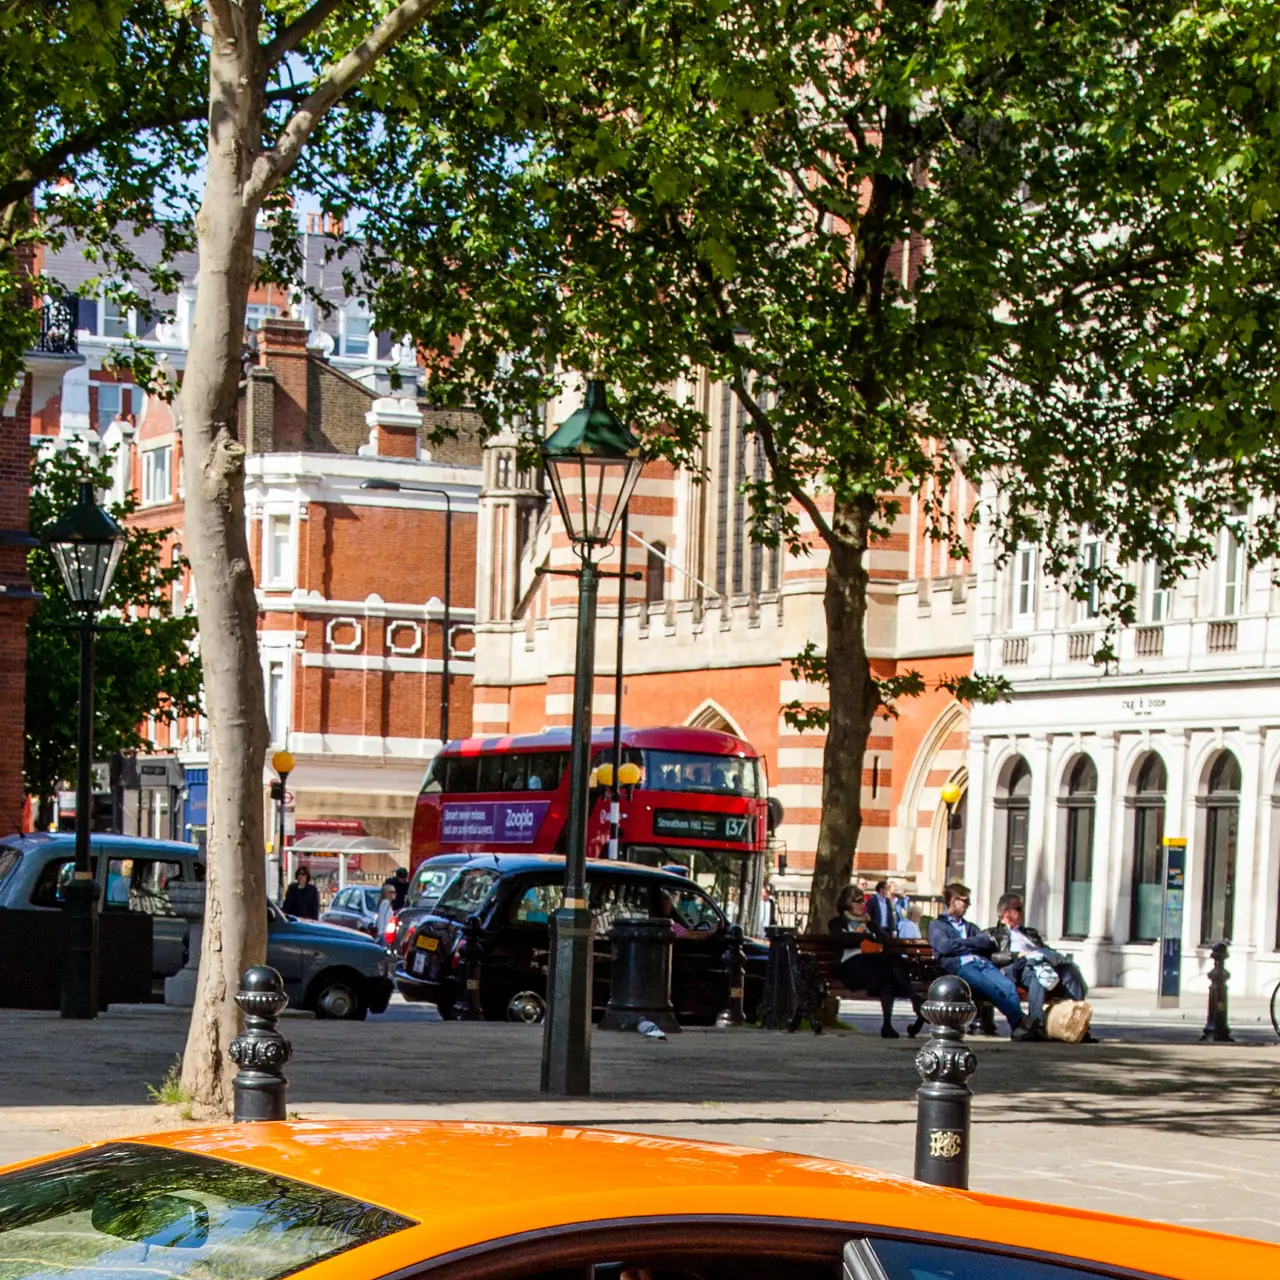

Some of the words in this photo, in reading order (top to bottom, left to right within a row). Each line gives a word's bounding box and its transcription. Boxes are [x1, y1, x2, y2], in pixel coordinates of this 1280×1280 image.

[505, 808, 534, 831] Zoopla
[657, 817, 689, 830] Streatham
[690, 819, 702, 831] Hill
[725, 818, 747, 837] 137
